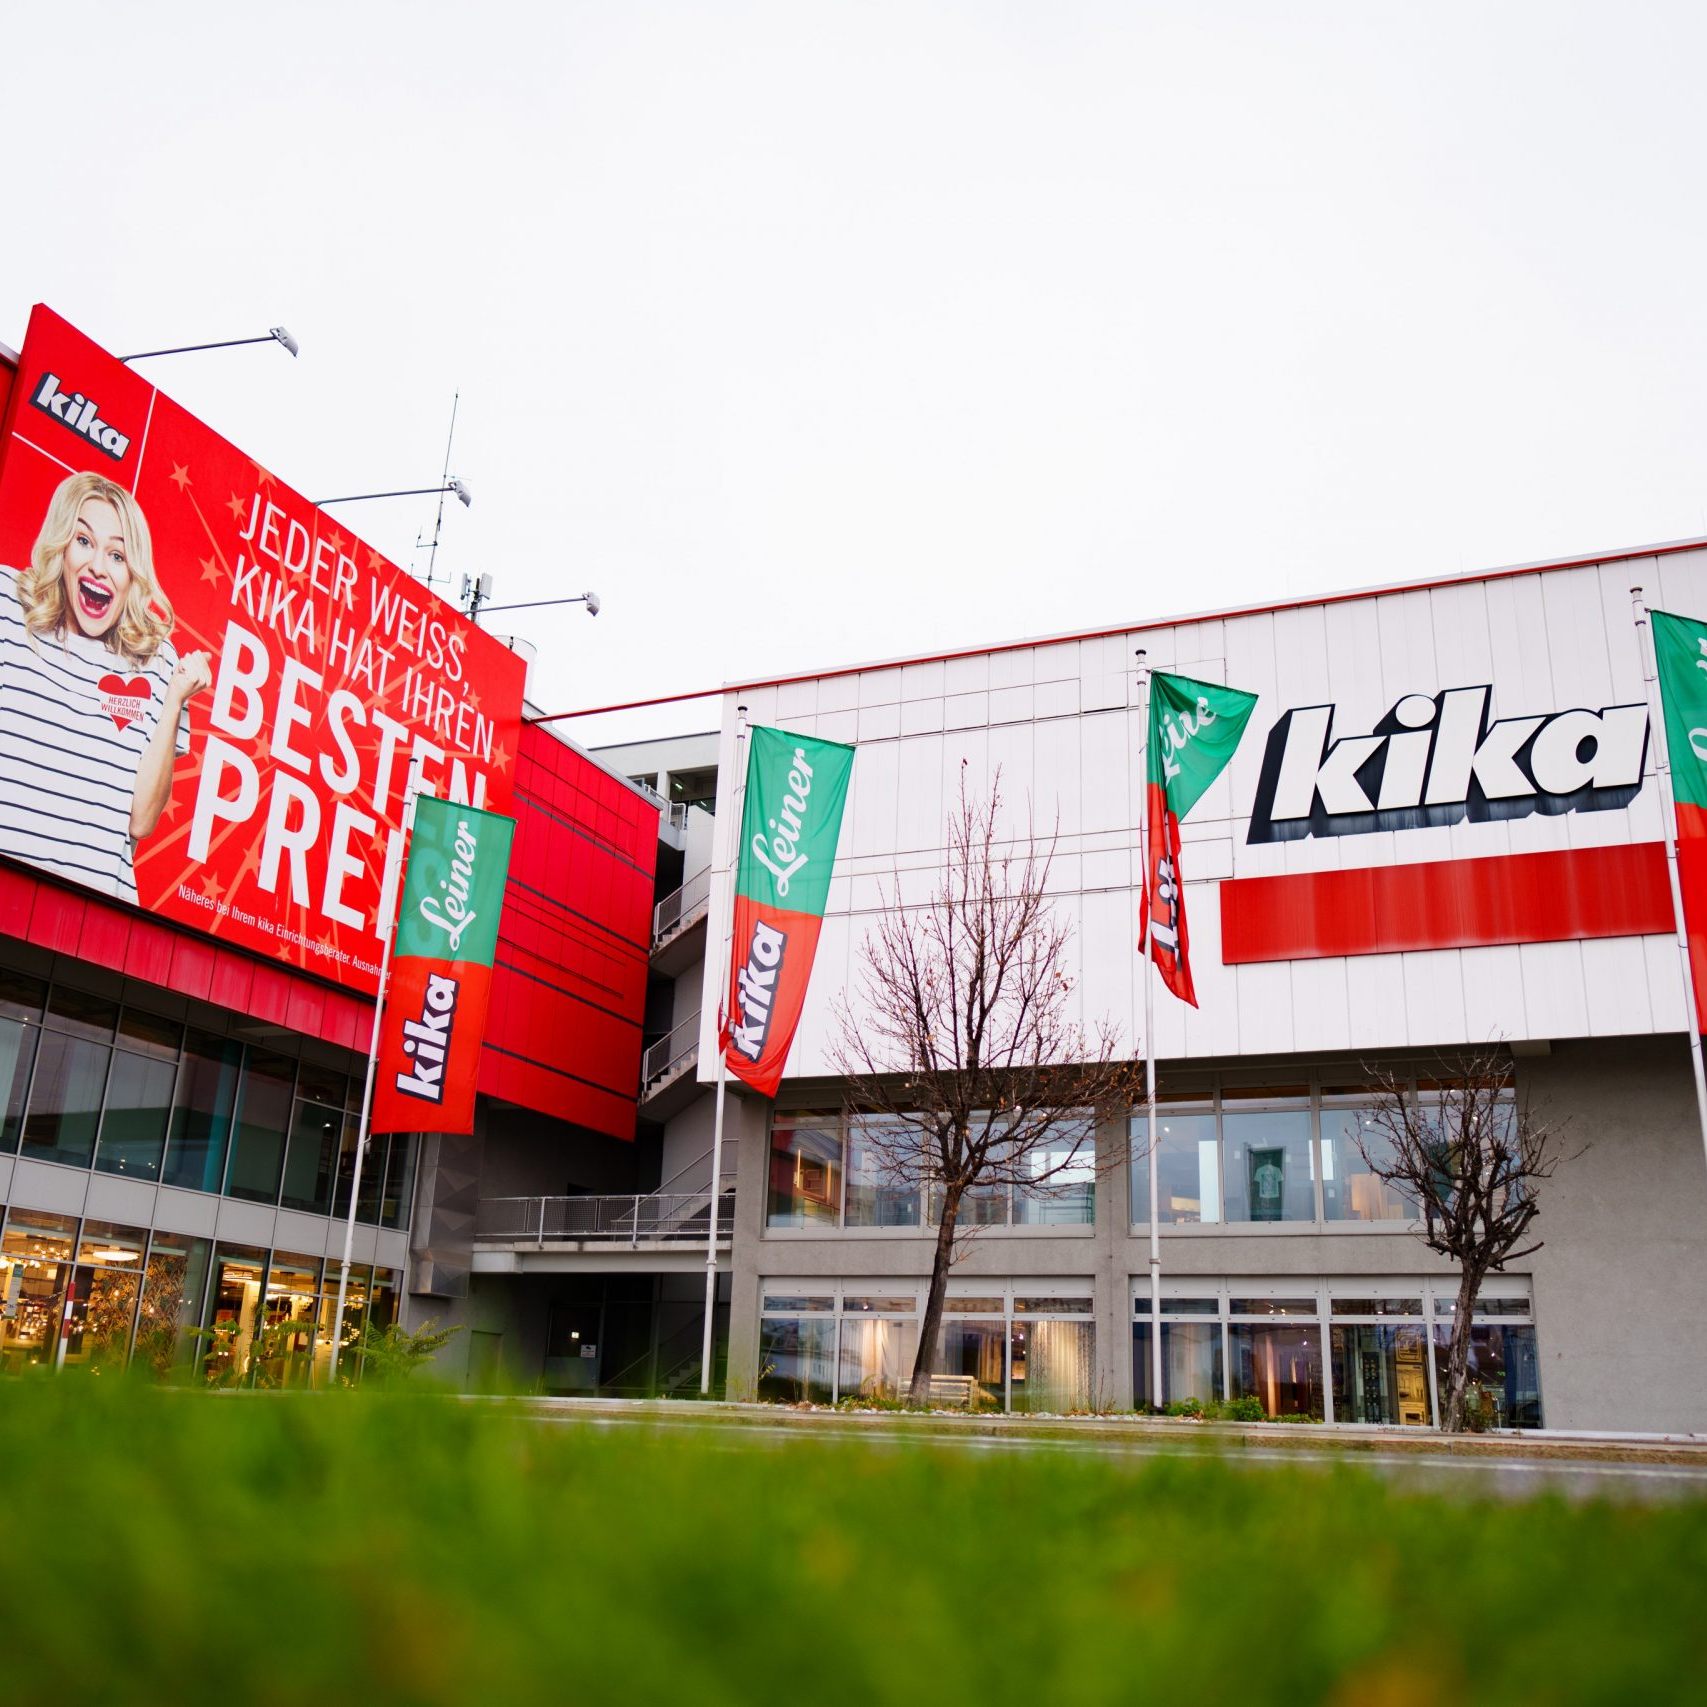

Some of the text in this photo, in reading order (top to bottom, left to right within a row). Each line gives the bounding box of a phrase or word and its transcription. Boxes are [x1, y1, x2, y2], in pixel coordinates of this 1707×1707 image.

[32, 372, 131, 460] kika
[231, 554, 494, 764] KIKA HAT IHREN
[239, 493, 469, 697] JEDER WEISS,
[101, 703, 145, 723] WILLKOMMEN
[108, 696, 141, 709] HERZLICH
[1254, 684, 1650, 838] kika
[420, 821, 478, 951] Leiner
[752, 747, 815, 897] Leiner
[178, 884, 215, 911] Näheres
[216, 899, 230, 916] bei
[231, 904, 255, 926] Ihrem
[257, 915, 274, 935] kika
[396, 972, 458, 1102] kika
[732, 920, 787, 1062] kika
